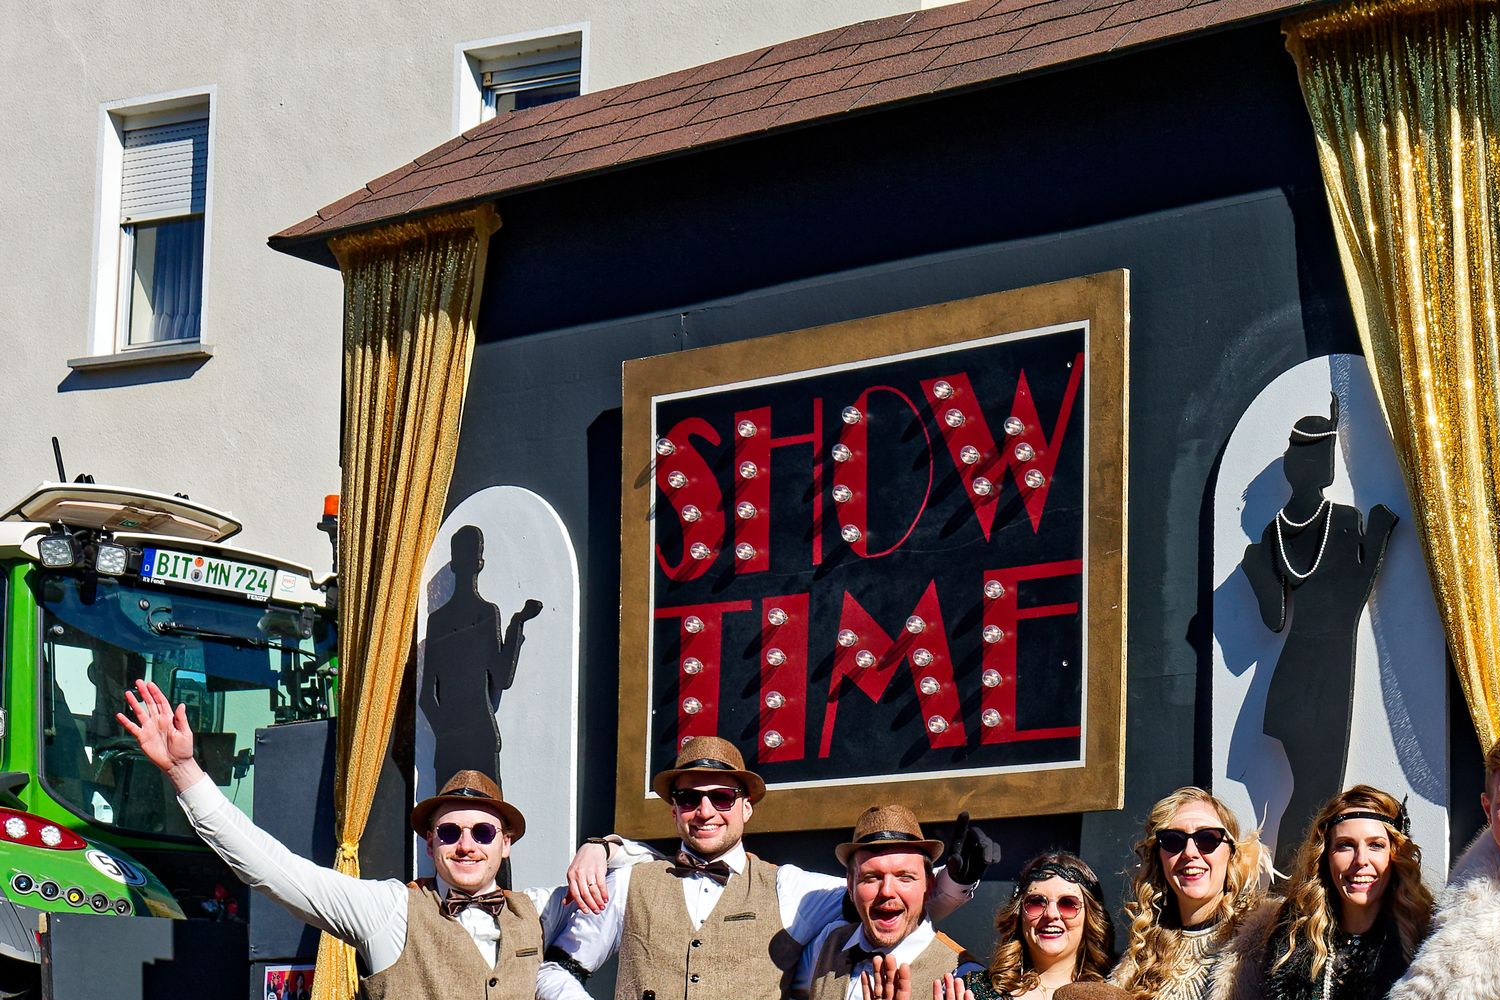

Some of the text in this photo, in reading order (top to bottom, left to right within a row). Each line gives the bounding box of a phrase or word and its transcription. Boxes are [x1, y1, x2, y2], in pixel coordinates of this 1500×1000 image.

[656, 352, 1085, 583] SHOW
[144, 564, 150, 572] D
[156, 552, 193, 580] BIT
[205, 561, 231, 587] MN
[234, 565, 268, 593] 724
[654, 559, 1083, 764] TIME
[95, 854, 138, 879] 50
